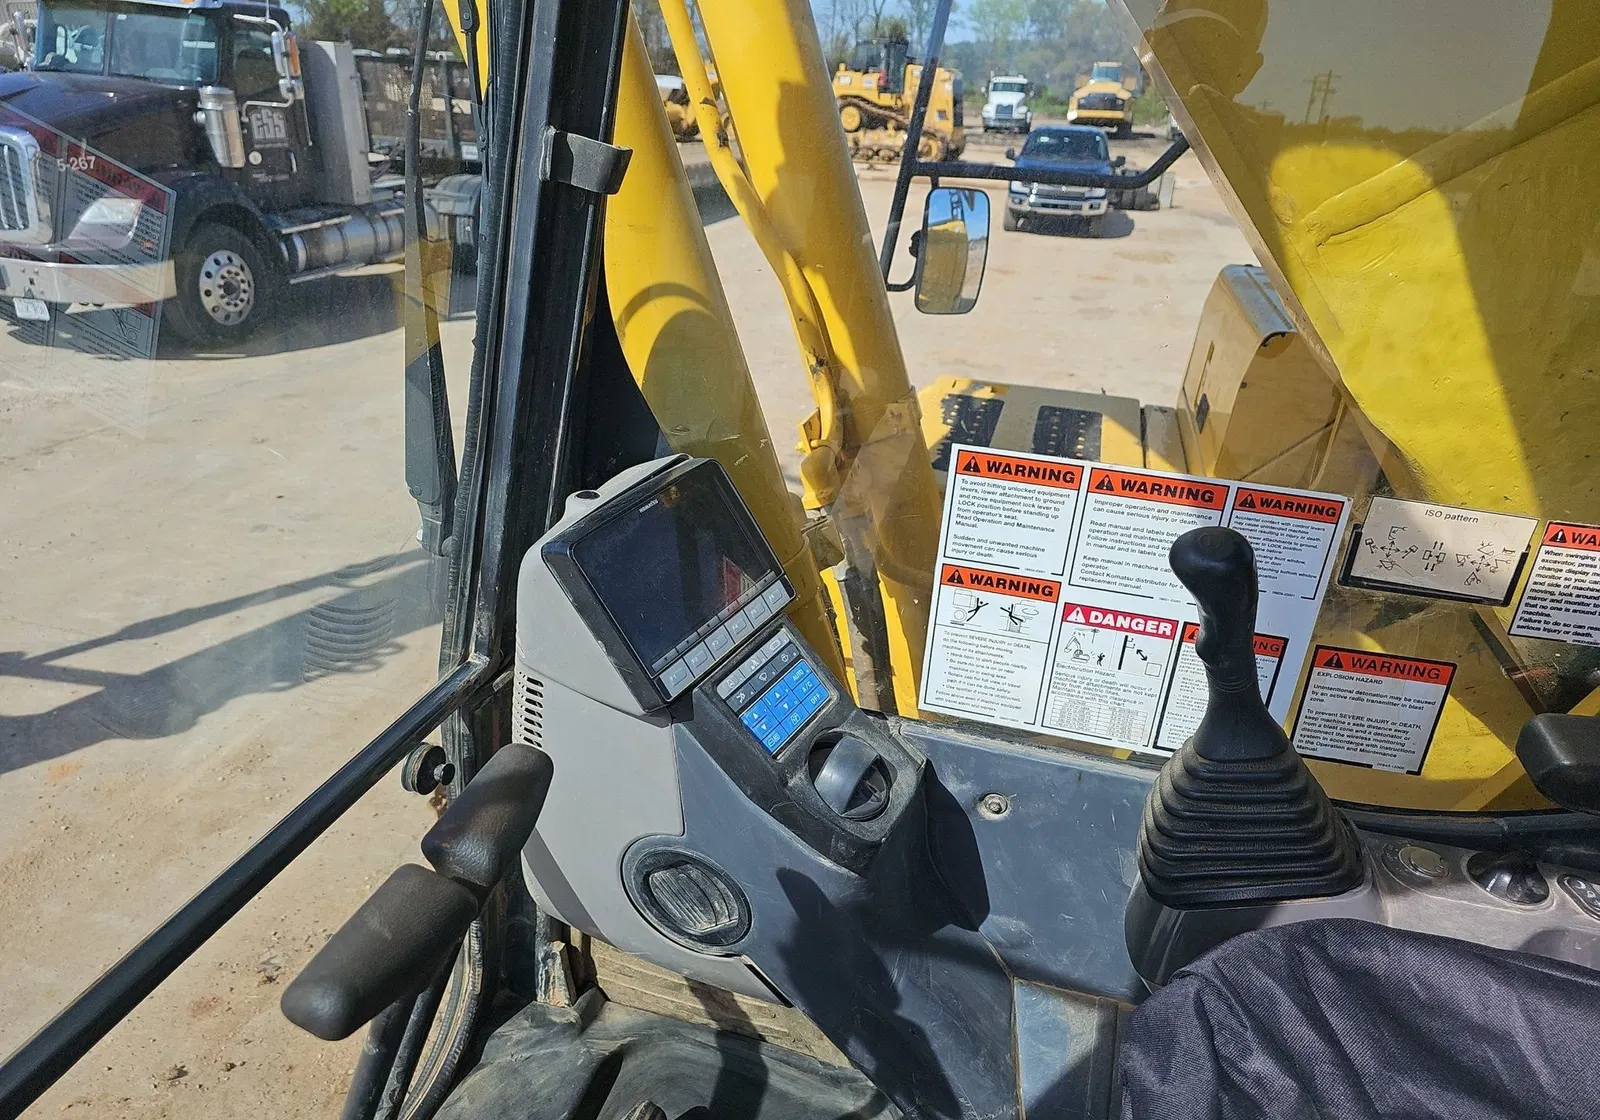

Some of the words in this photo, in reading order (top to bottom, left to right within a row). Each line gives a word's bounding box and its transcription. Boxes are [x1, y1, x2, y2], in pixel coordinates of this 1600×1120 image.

[57, 155, 96, 172] 5-267
[985, 460, 1076, 484] WARNING
[959, 485, 979, 493] levers,
[998, 491, 1033, 500] attachment
[1042, 497, 1065, 506] ground
[986, 482, 1006, 491] hitting
[1007, 485, 1036, 493] unlocked
[1036, 489, 1070, 500] equipment
[1119, 478, 1215, 503] WARNING
[989, 496, 1021, 507] equipment
[1257, 497, 1337, 517] WARNING
[971, 508, 1002, 519] operator's
[976, 502, 1001, 511] position
[1001, 505, 1021, 513] before
[1022, 509, 1049, 519] standing
[1093, 498, 1122, 509] Improper
[1124, 502, 1155, 513] operation
[1170, 509, 1213, 520] maintenance
[954, 519, 978, 528] Manual.
[972, 515, 1002, 526] Operation
[1015, 522, 1055, 532] Maintenance
[1126, 510, 1150, 518] serious
[1150, 514, 1169, 523] injury
[1424, 508, 1444, 519] ISO
[1443, 510, 1480, 526] pattern
[1089, 519, 1106, 527] Read
[1107, 522, 1131, 530] manual
[952, 533, 975, 541] Sudden
[988, 539, 1018, 548] unwanted
[1019, 543, 1045, 552] machine
[1086, 533, 1107, 541] Follow
[1108, 537, 1146, 547] instructions
[950, 546, 967, 555] injury
[976, 550, 994, 558] death.
[952, 539, 983, 549] movement
[1015, 550, 1037, 558] serious
[1540, 557, 1576, 566] excavator,
[1576, 562, 1597, 570] press
[1564, 552, 1597, 562] swinging
[1079, 567, 1105, 576] Contact
[1105, 572, 1134, 581] Komatsu
[1134, 576, 1167, 586] distributor
[1534, 572, 1562, 580] monitor
[1536, 564, 1564, 574] change
[1563, 568, 1590, 577] display
[968, 572, 1054, 597] WARNING
[1078, 574, 1117, 587] replacement
[1117, 581, 1142, 590] manual.
[1528, 587, 1557, 597] moving,
[1574, 592, 1600, 600] around
[1563, 598, 1592, 607] monitor
[1518, 615, 1542, 623] Failure
[1521, 608, 1553, 617] machine.
[1088, 610, 1173, 636] DANGER
[1515, 623, 1542, 631] serious
[1541, 626, 1562, 635] injury
[1055, 663, 1093, 673] Electrocution
[1094, 669, 1117, 677] Hazard.
[1349, 656, 1441, 680] WARNING
[792, 669, 805, 682] AUTO
[1316, 671, 1354, 681] EXPLOSION
[1354, 676, 1383, 685] HAZARD
[801, 681, 813, 694] A/C
[1313, 683, 1354, 694] Unintentional
[1354, 689, 1388, 698] detonation
[810, 693, 821, 705] OFF
[1310, 689, 1319, 697] by
[1365, 697, 1399, 707] transmitter
[1314, 709, 1338, 719] prevent
[1338, 713, 1364, 721] SEVERE
[1365, 717, 1388, 725] INJURY
[1397, 722, 1422, 730] DEATH,
[1315, 741, 1345, 751] Operation
[1358, 748, 1397, 758] Maintenance
